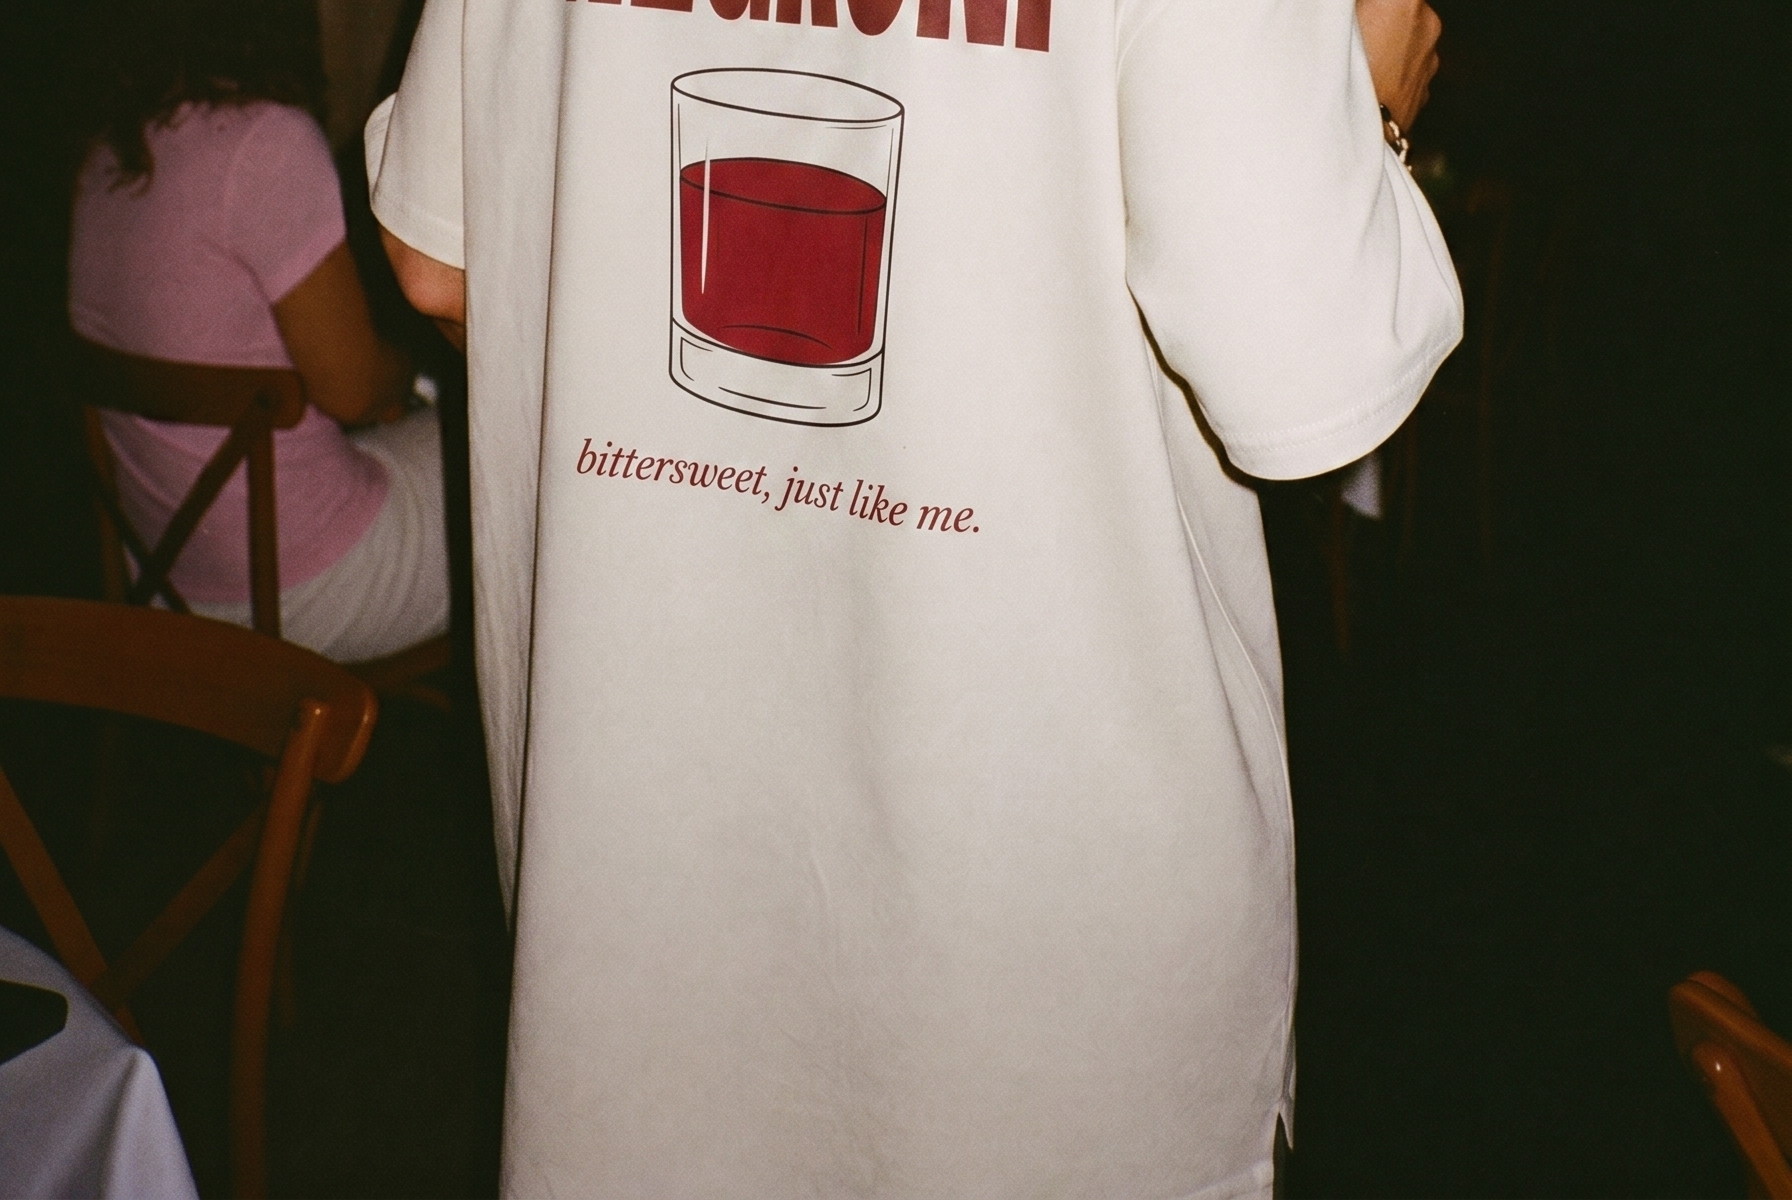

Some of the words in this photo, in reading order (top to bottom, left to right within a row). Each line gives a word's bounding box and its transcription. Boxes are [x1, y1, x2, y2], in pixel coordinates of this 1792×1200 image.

[576, 438, 770, 504] bittersweet,
[775, 466, 844, 511] just
[849, 479, 908, 526] like
[916, 504, 981, 533] me.
